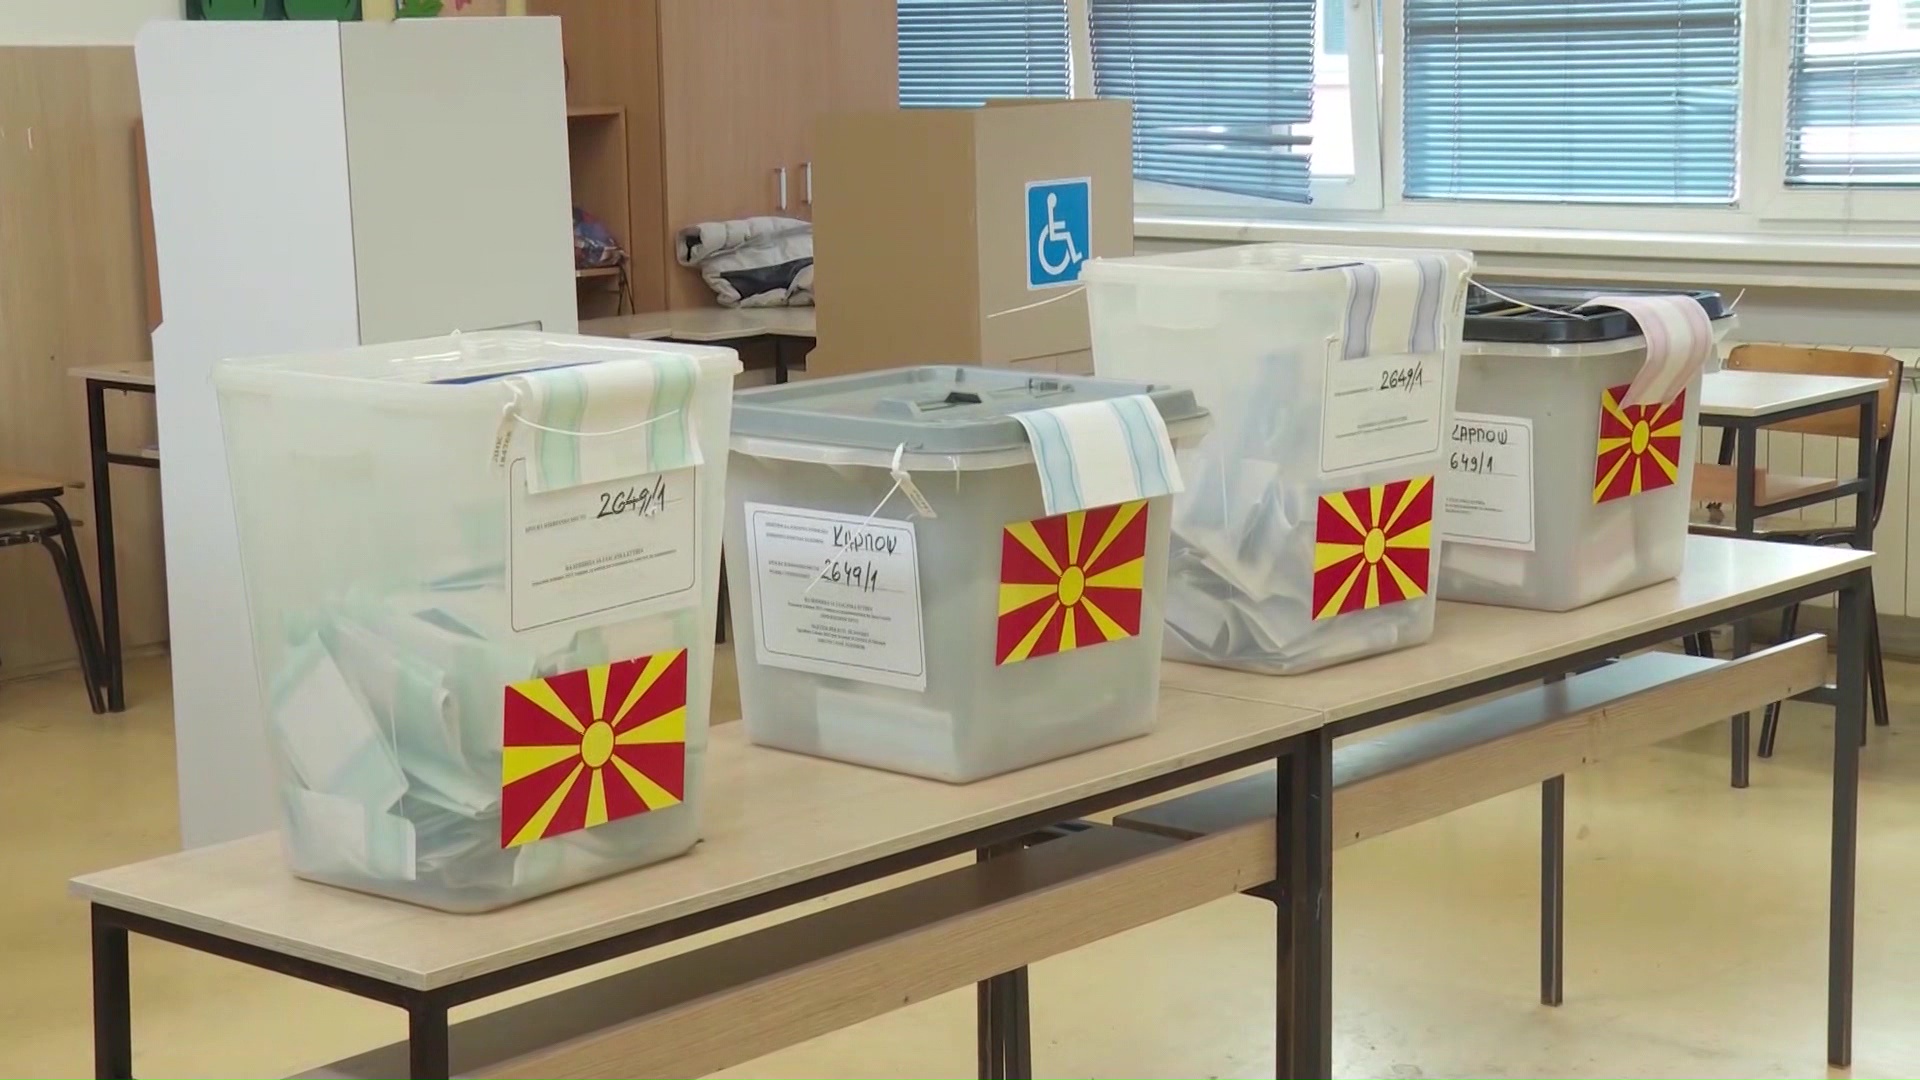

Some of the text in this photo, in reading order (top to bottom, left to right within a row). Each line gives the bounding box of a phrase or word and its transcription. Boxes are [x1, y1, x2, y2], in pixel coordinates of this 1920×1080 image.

[1380, 361, 1423, 393] 2649/1
[1450, 451, 1493, 474] 649/1
[596, 474, 666, 520] 2649/1
[821, 558, 879, 592] 2649/1
